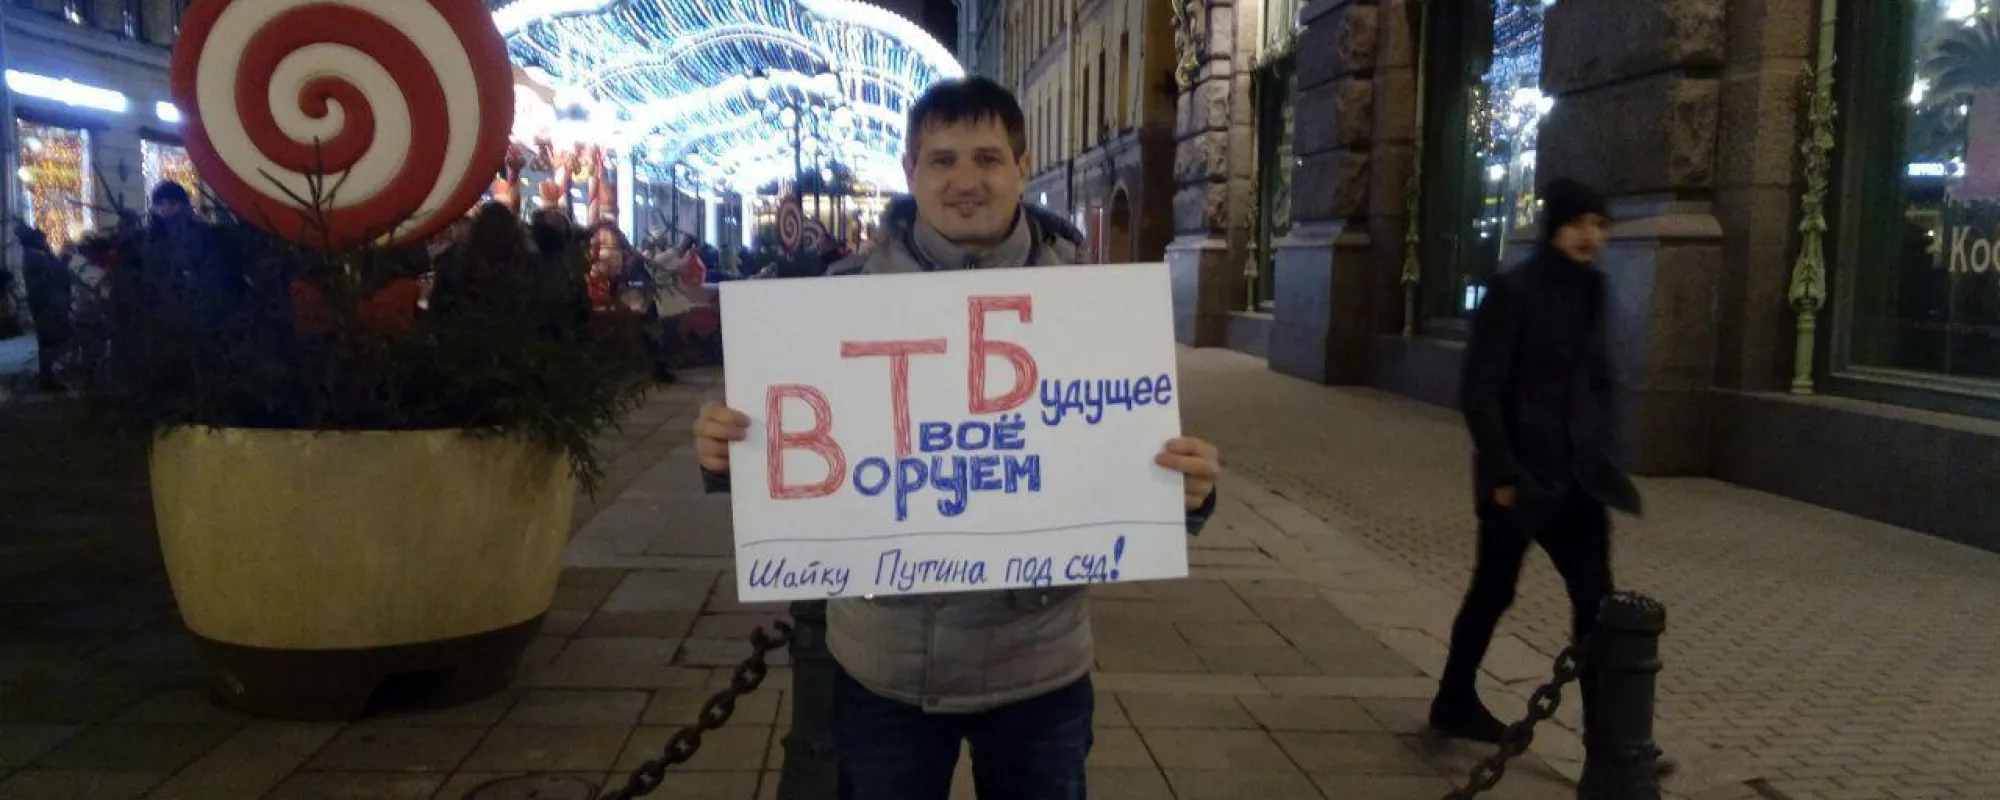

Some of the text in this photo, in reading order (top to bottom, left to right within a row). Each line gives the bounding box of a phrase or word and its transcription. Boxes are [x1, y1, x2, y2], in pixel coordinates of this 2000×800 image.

[967, 295, 1172, 426] Будущее
[749, 534, 1126, 596] Шайку Путина под суд!
